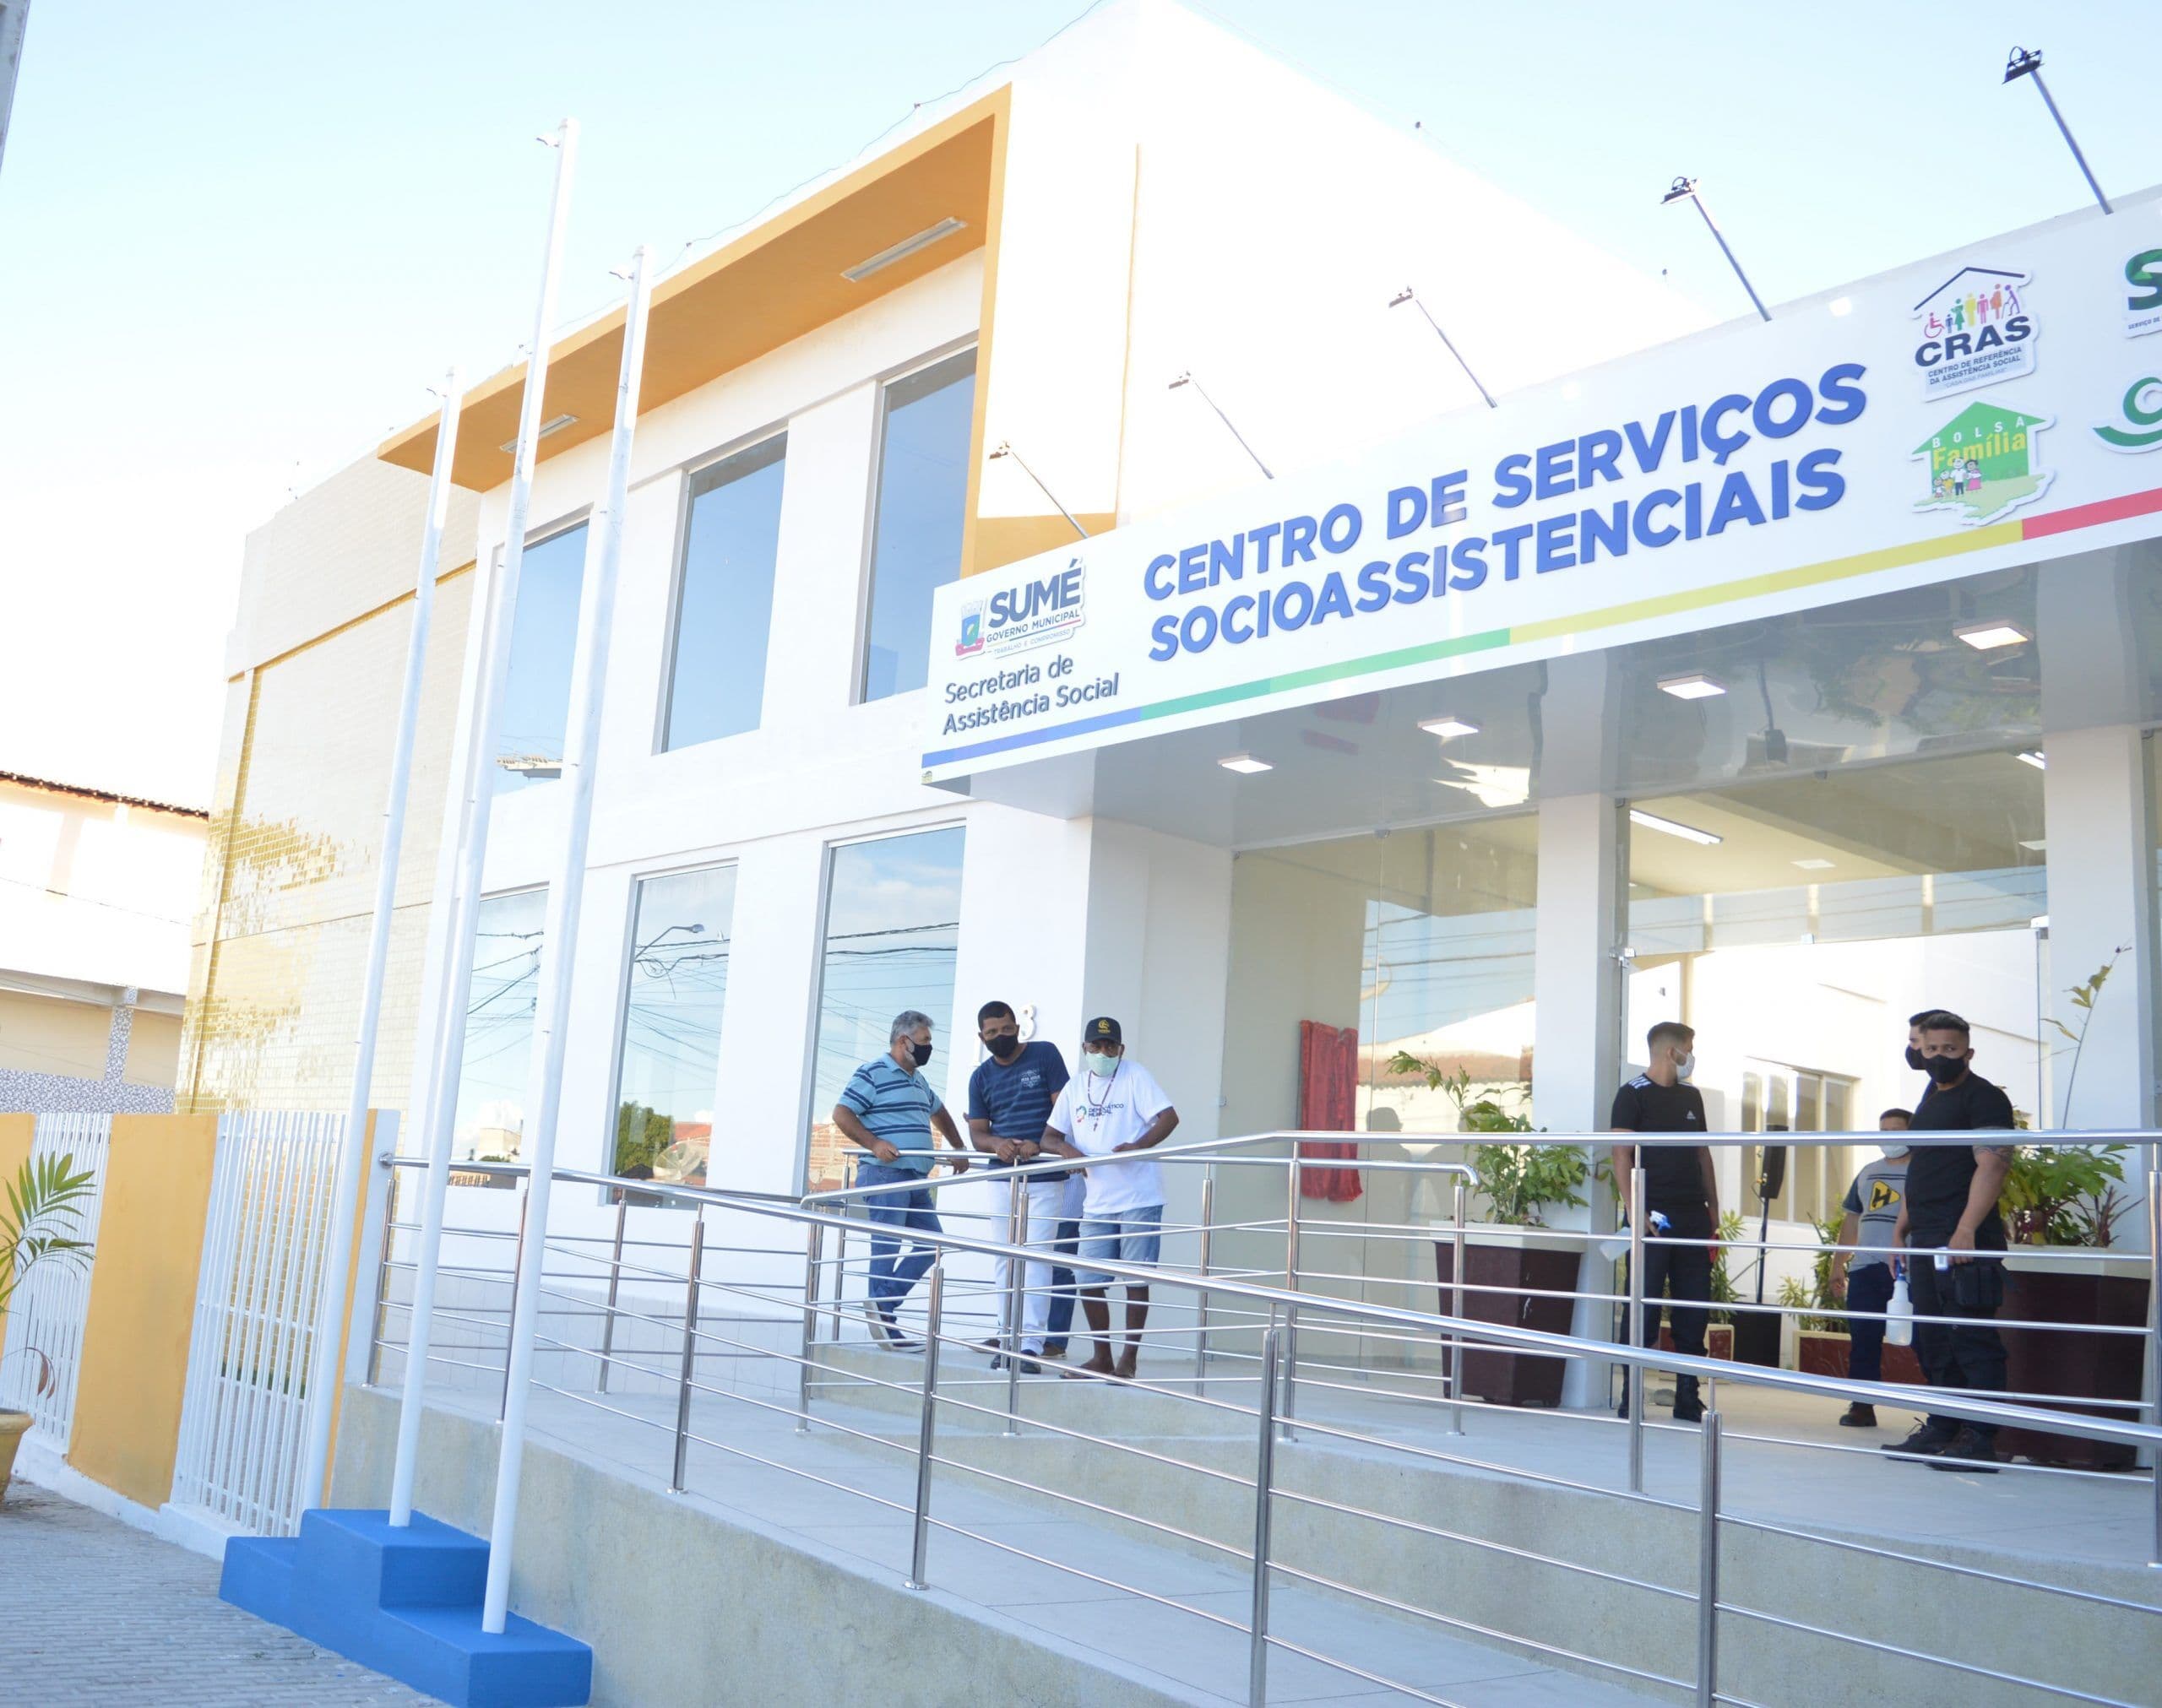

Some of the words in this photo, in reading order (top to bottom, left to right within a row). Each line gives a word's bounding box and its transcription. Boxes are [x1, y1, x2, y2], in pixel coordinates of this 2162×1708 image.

[1915, 316, 2031, 367] CRAS
[1928, 363, 1958, 377] CENTRO
[1960, 361, 1972, 369] DE
[1974, 346, 2022, 365] REFERÊNCIA
[1930, 377, 1940, 385] DA
[1942, 362, 1991, 382] ASSISTÊNCIA
[1993, 355, 2021, 367] SOCIAL
[1932, 431, 2027, 470] Família
[1143, 503, 1362, 600] CENTRO
[1386, 469, 1467, 540] DE
[1491, 363, 1868, 507] SERVIÇOS
[1148, 448, 1845, 661] SOCIOASSISTENCIAIS
[988, 558, 1082, 628] SUMÉ
[986, 624, 1029, 643] GOVERNO
[1031, 610, 1080, 630] MUNICIPAL
[945, 664, 1040, 703] Secretaria
[1047, 654, 1073, 679] de
[942, 693, 1050, 735] Assistência
[1056, 672, 1119, 708] Social
[1871, 1187, 1892, 1207] H
